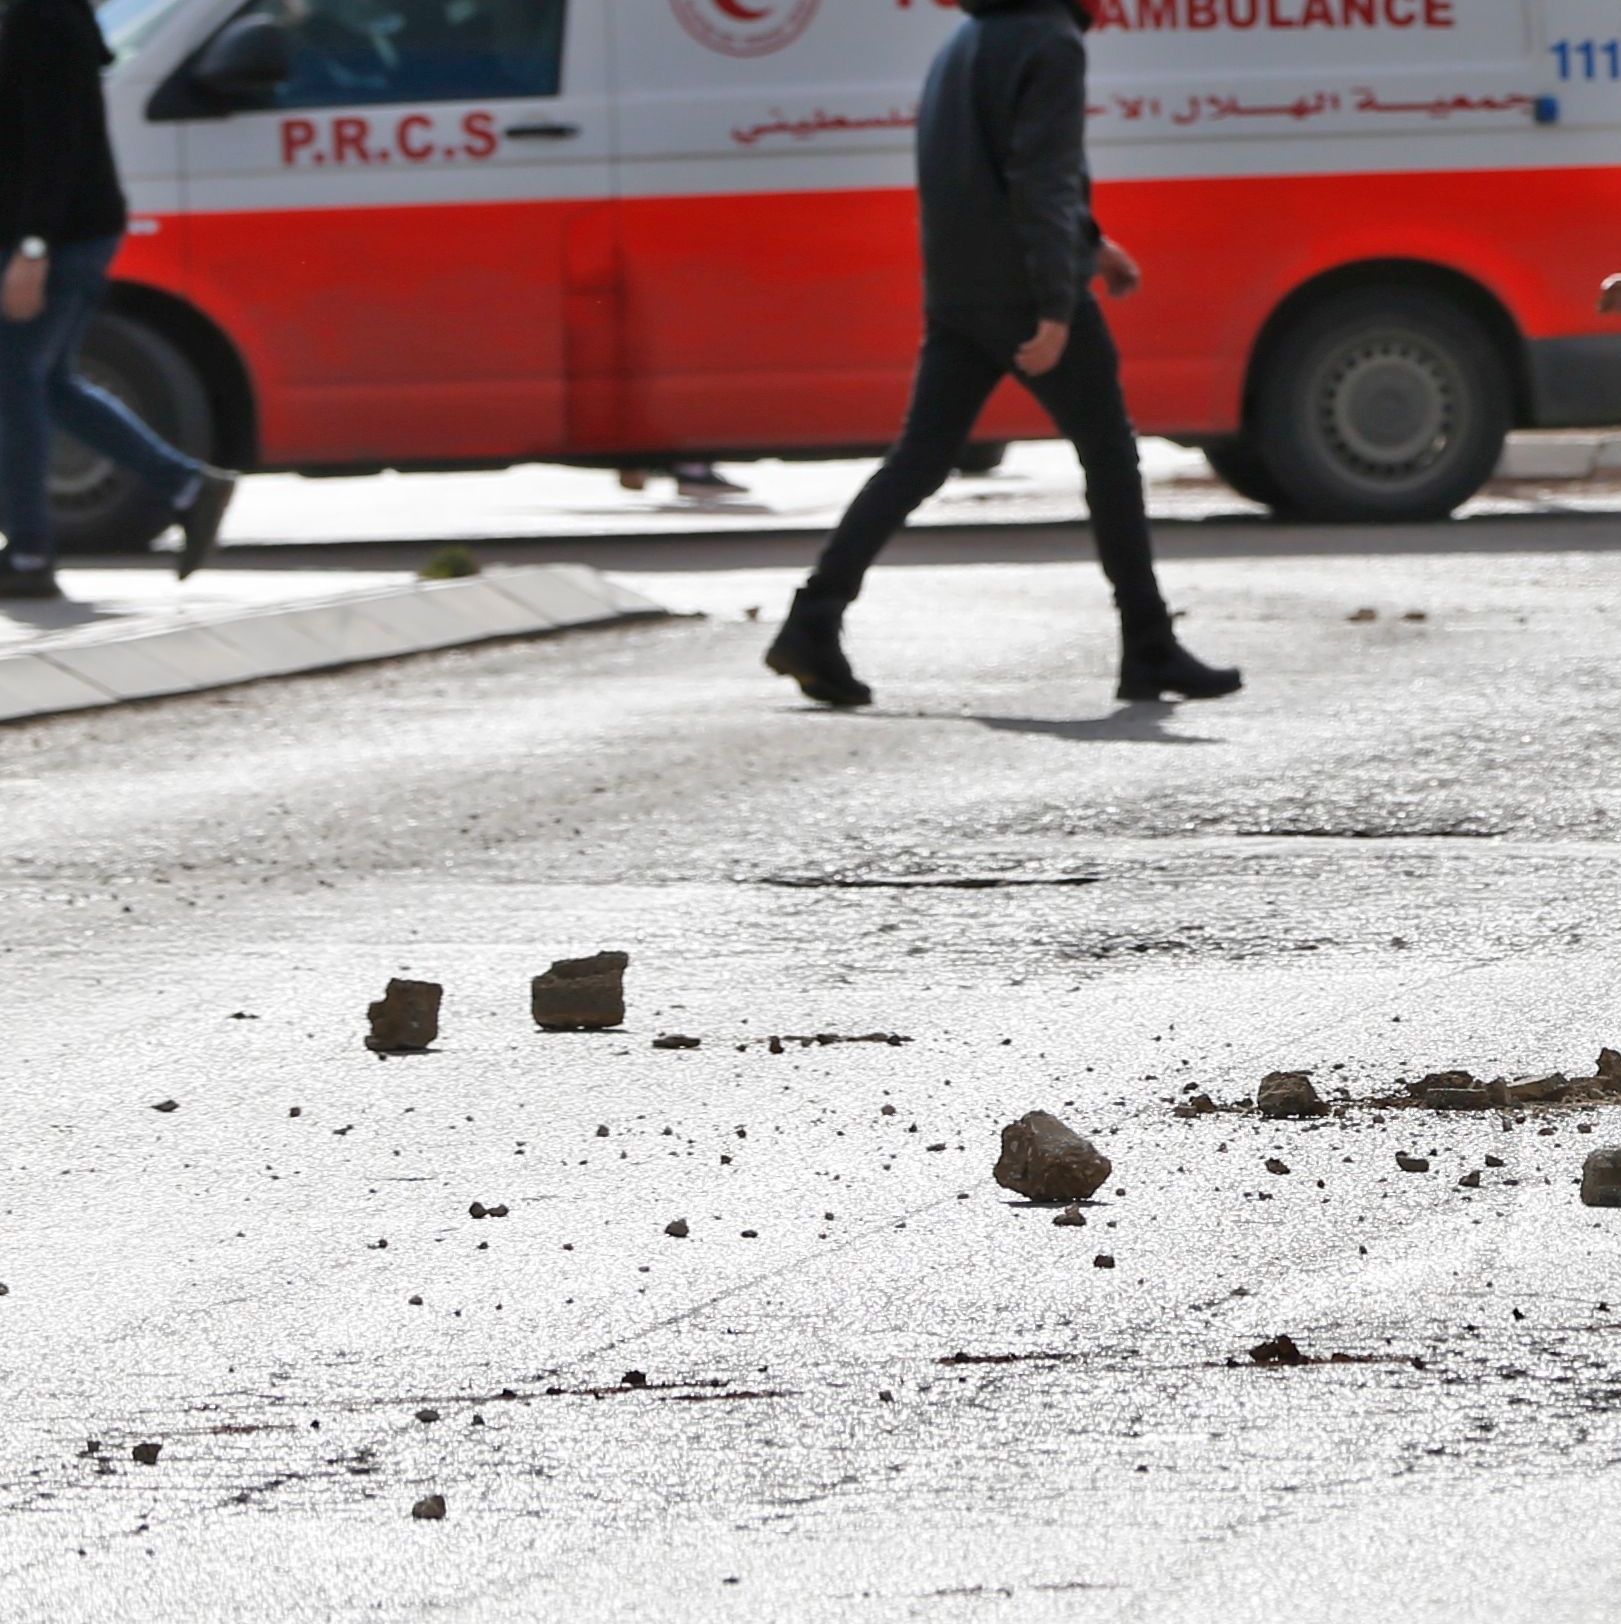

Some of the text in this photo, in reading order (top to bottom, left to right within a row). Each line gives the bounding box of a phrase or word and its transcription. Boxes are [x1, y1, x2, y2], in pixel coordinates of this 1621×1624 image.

[1549, 37, 1621, 80] 111
[1171, 88, 1342, 126] الهلال
[279, 110, 499, 167] P.R.C.S
